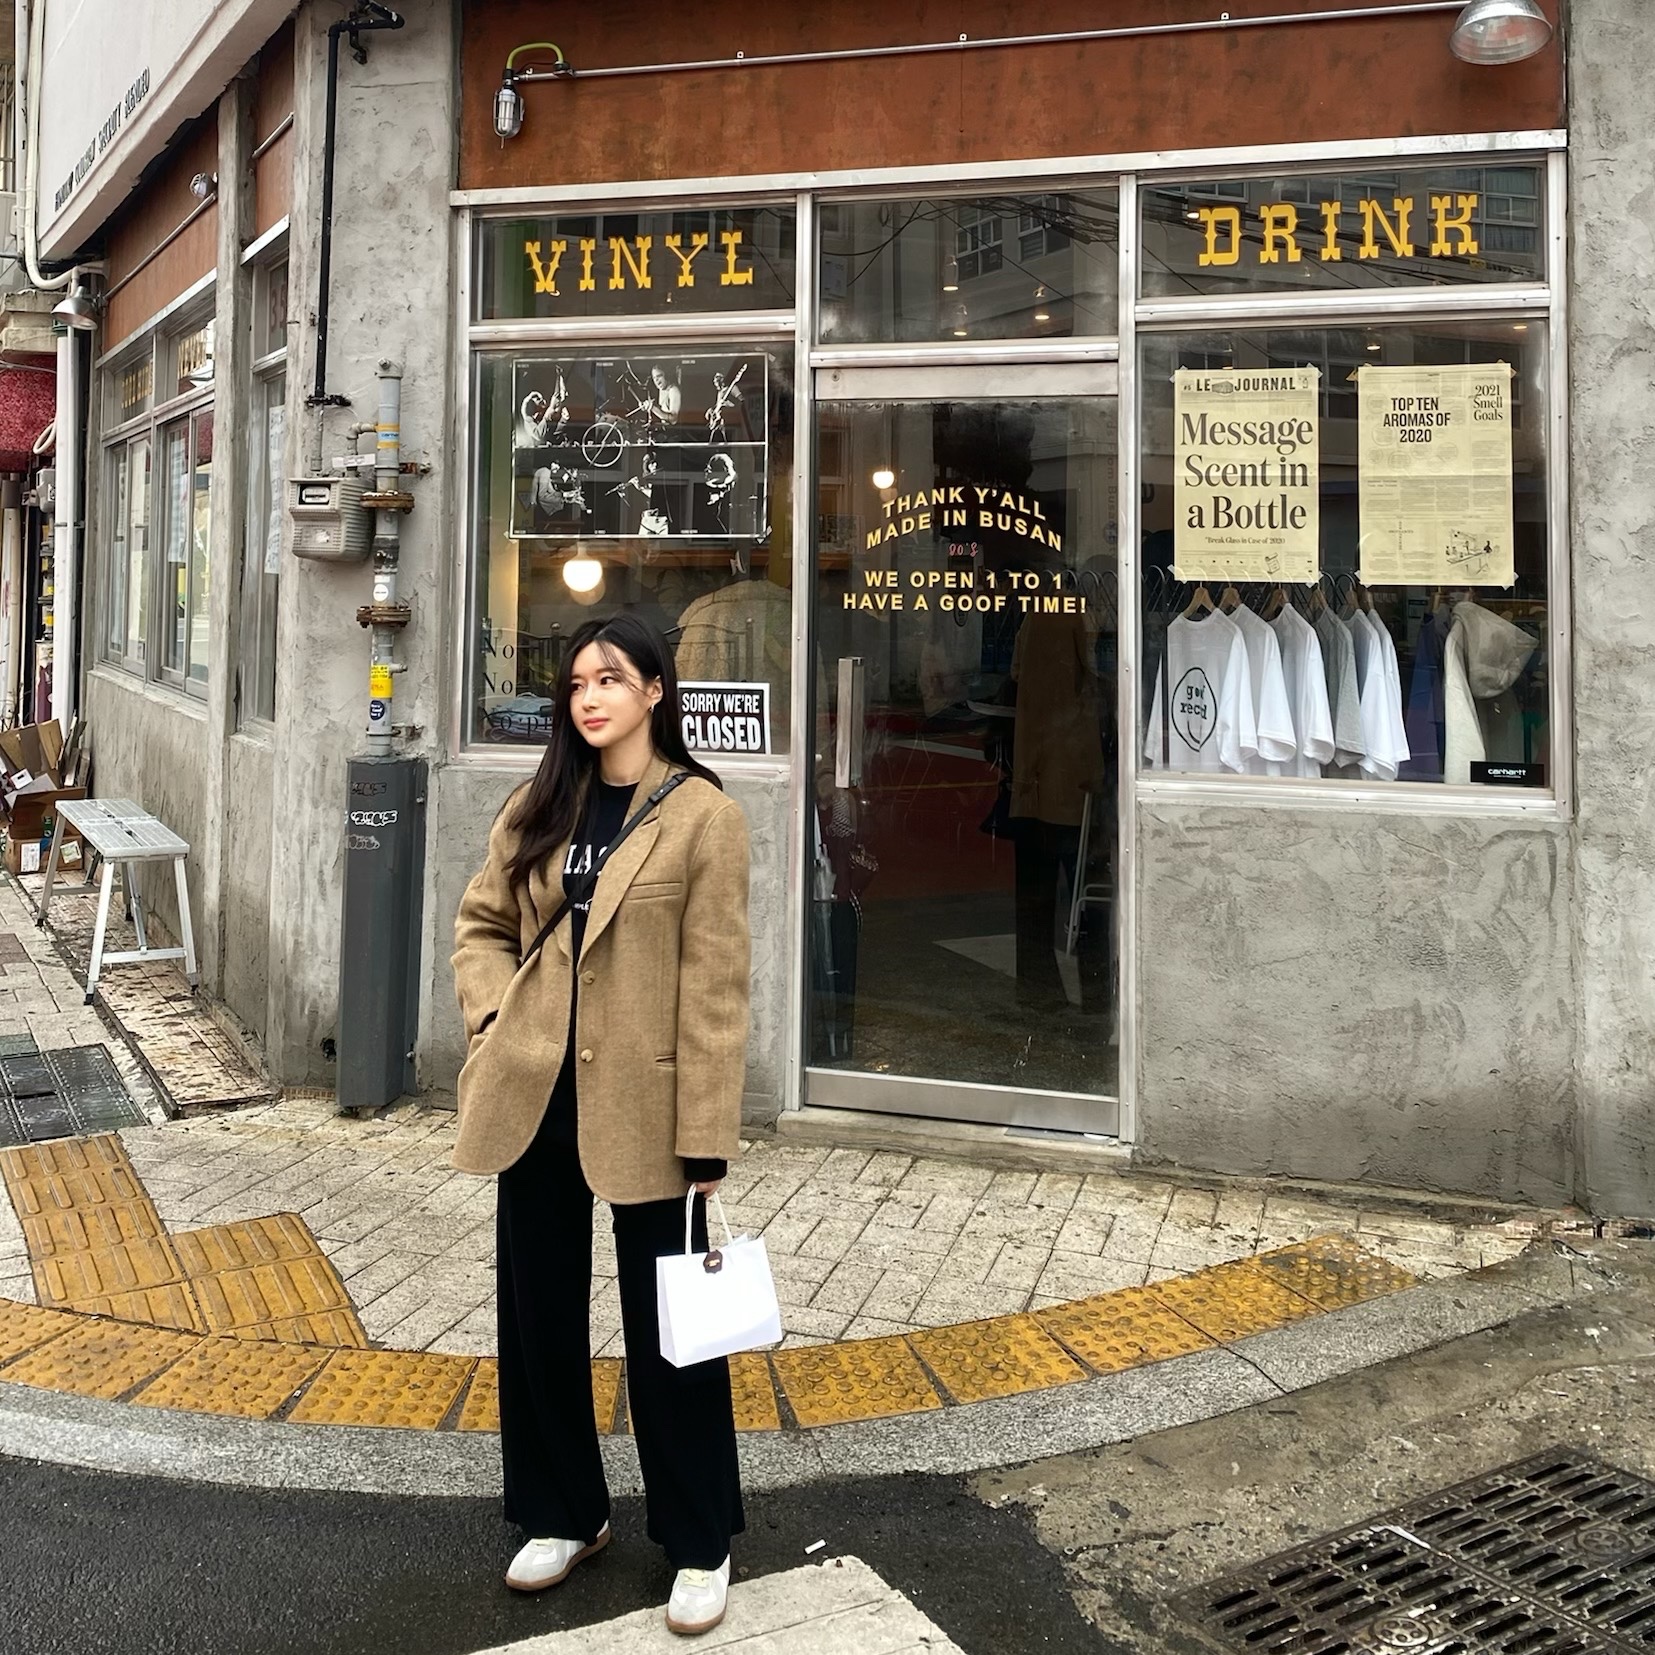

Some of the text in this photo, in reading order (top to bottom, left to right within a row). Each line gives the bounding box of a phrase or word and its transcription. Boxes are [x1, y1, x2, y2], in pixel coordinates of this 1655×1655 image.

[1198, 194, 1479, 267] DRINK
[524, 230, 755, 293] VINYL
[1196, 378, 1211, 391] LE
[1234, 377, 1296, 391] JOURNAL
[1475, 384, 1501, 396] 2021
[1391, 397, 1439, 411] TOP TEN
[1473, 396, 1503, 409] Smell
[1383, 412, 1451, 427] AROMAS OF
[1473, 408, 1504, 421] Goals
[1181, 412, 1313, 455] Message
[1399, 429, 1432, 443] 2020
[1184, 453, 1309, 488] Scent in
[882, 486, 1047, 521] THANK Y'ALL
[1187, 492, 1307, 530] a Bottle
[866, 511, 932, 551] MADE
[943, 509, 967, 527] IN
[979, 510, 1062, 553] BUSAN
[864, 570, 1062, 590] WE OPEN 1 TO 1
[843, 593, 1087, 615] HAVE A GOOF TIME!
[484, 636, 515, 660] No
[482, 671, 513, 695] No
[681, 692, 760, 714] SORRY WE'RE
[681, 714, 762, 751] CLOSED
[1487, 768, 1526, 776] carhartt
